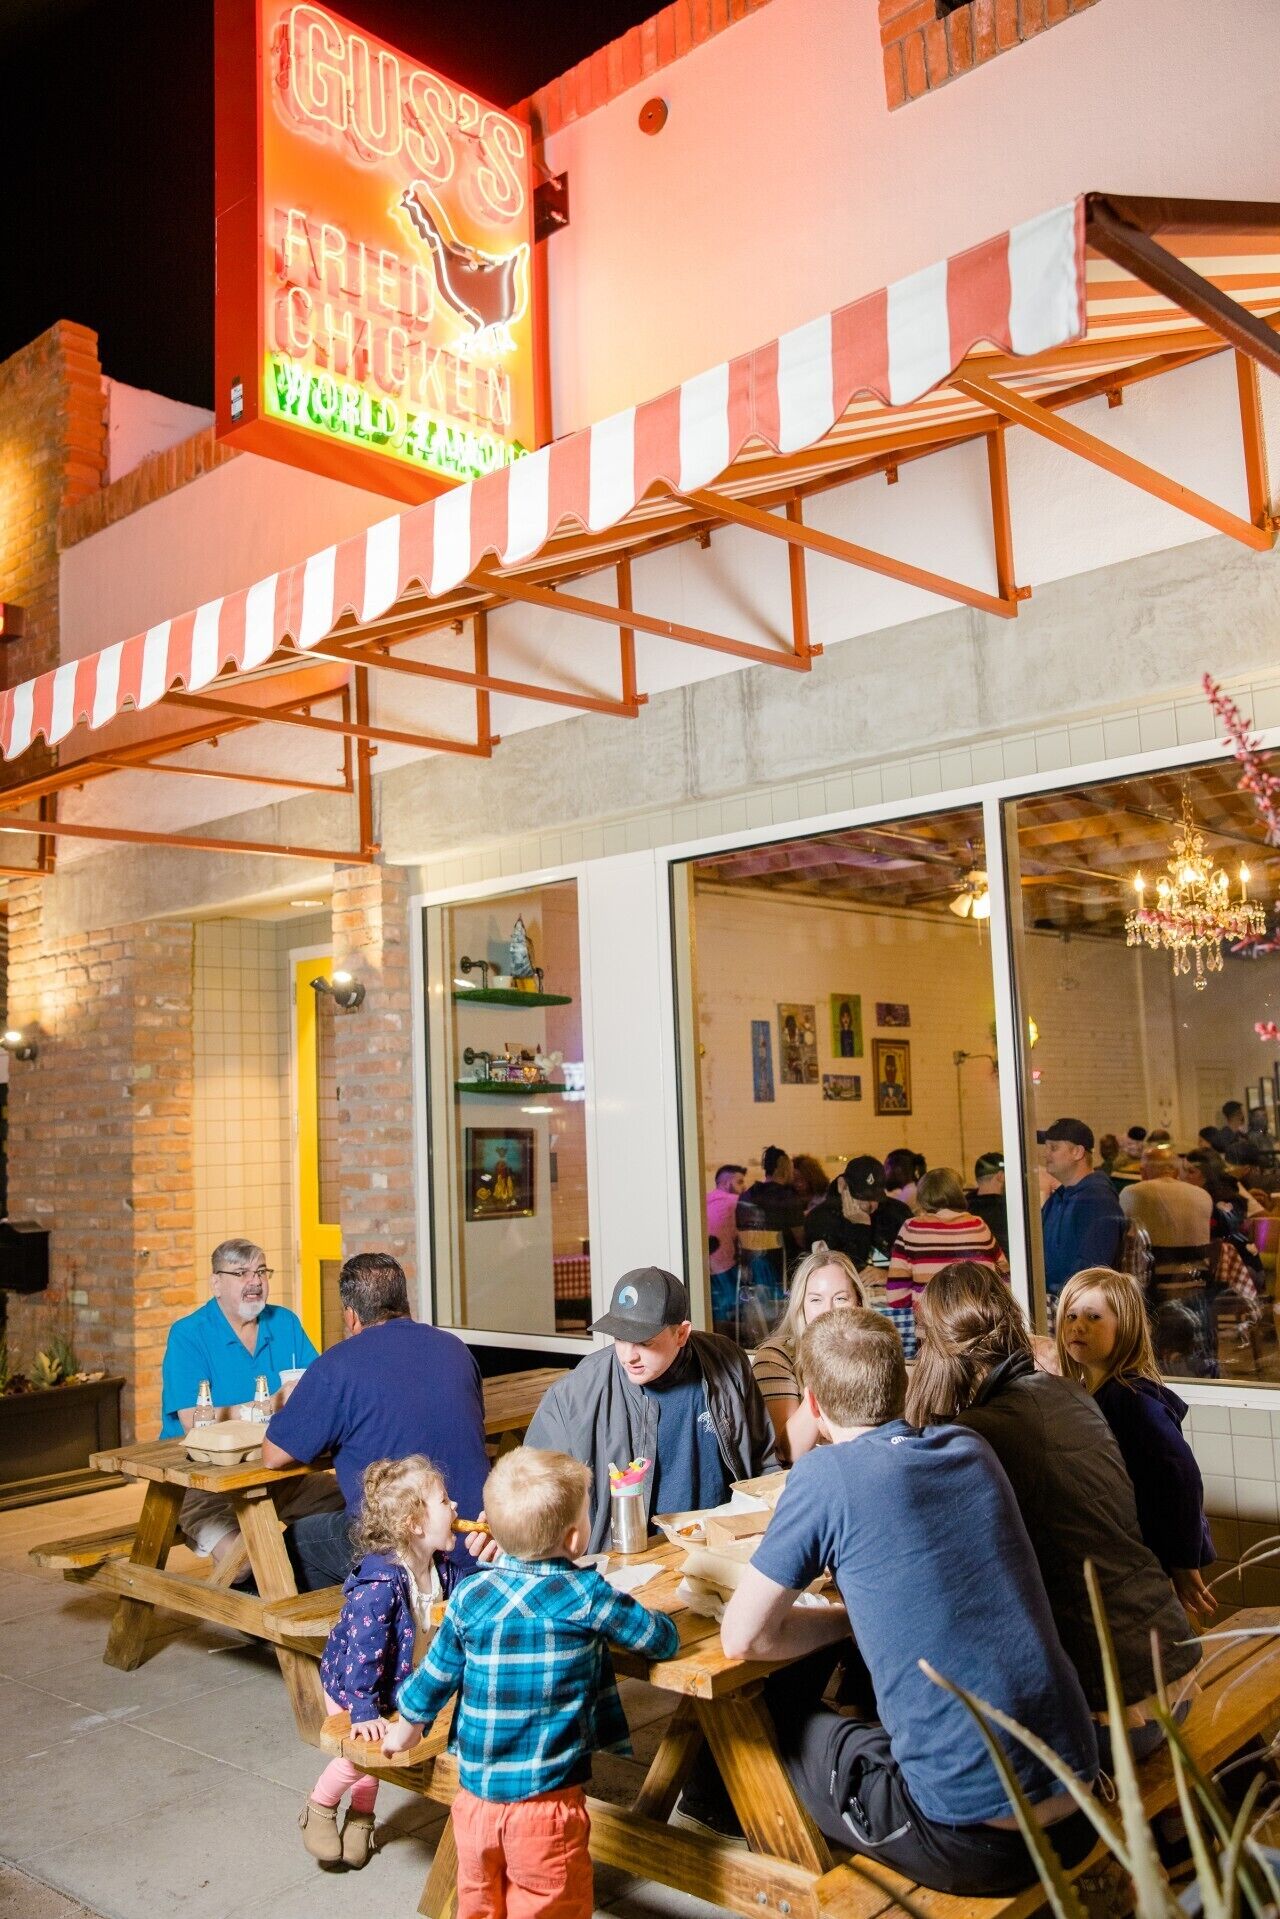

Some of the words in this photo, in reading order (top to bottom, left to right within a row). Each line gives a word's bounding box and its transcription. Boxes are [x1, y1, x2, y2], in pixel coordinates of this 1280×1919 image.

[276, 207, 436, 327] FRIED
[274, 361, 400, 443] WORLD
[275, 285, 513, 432] CHICKEN
